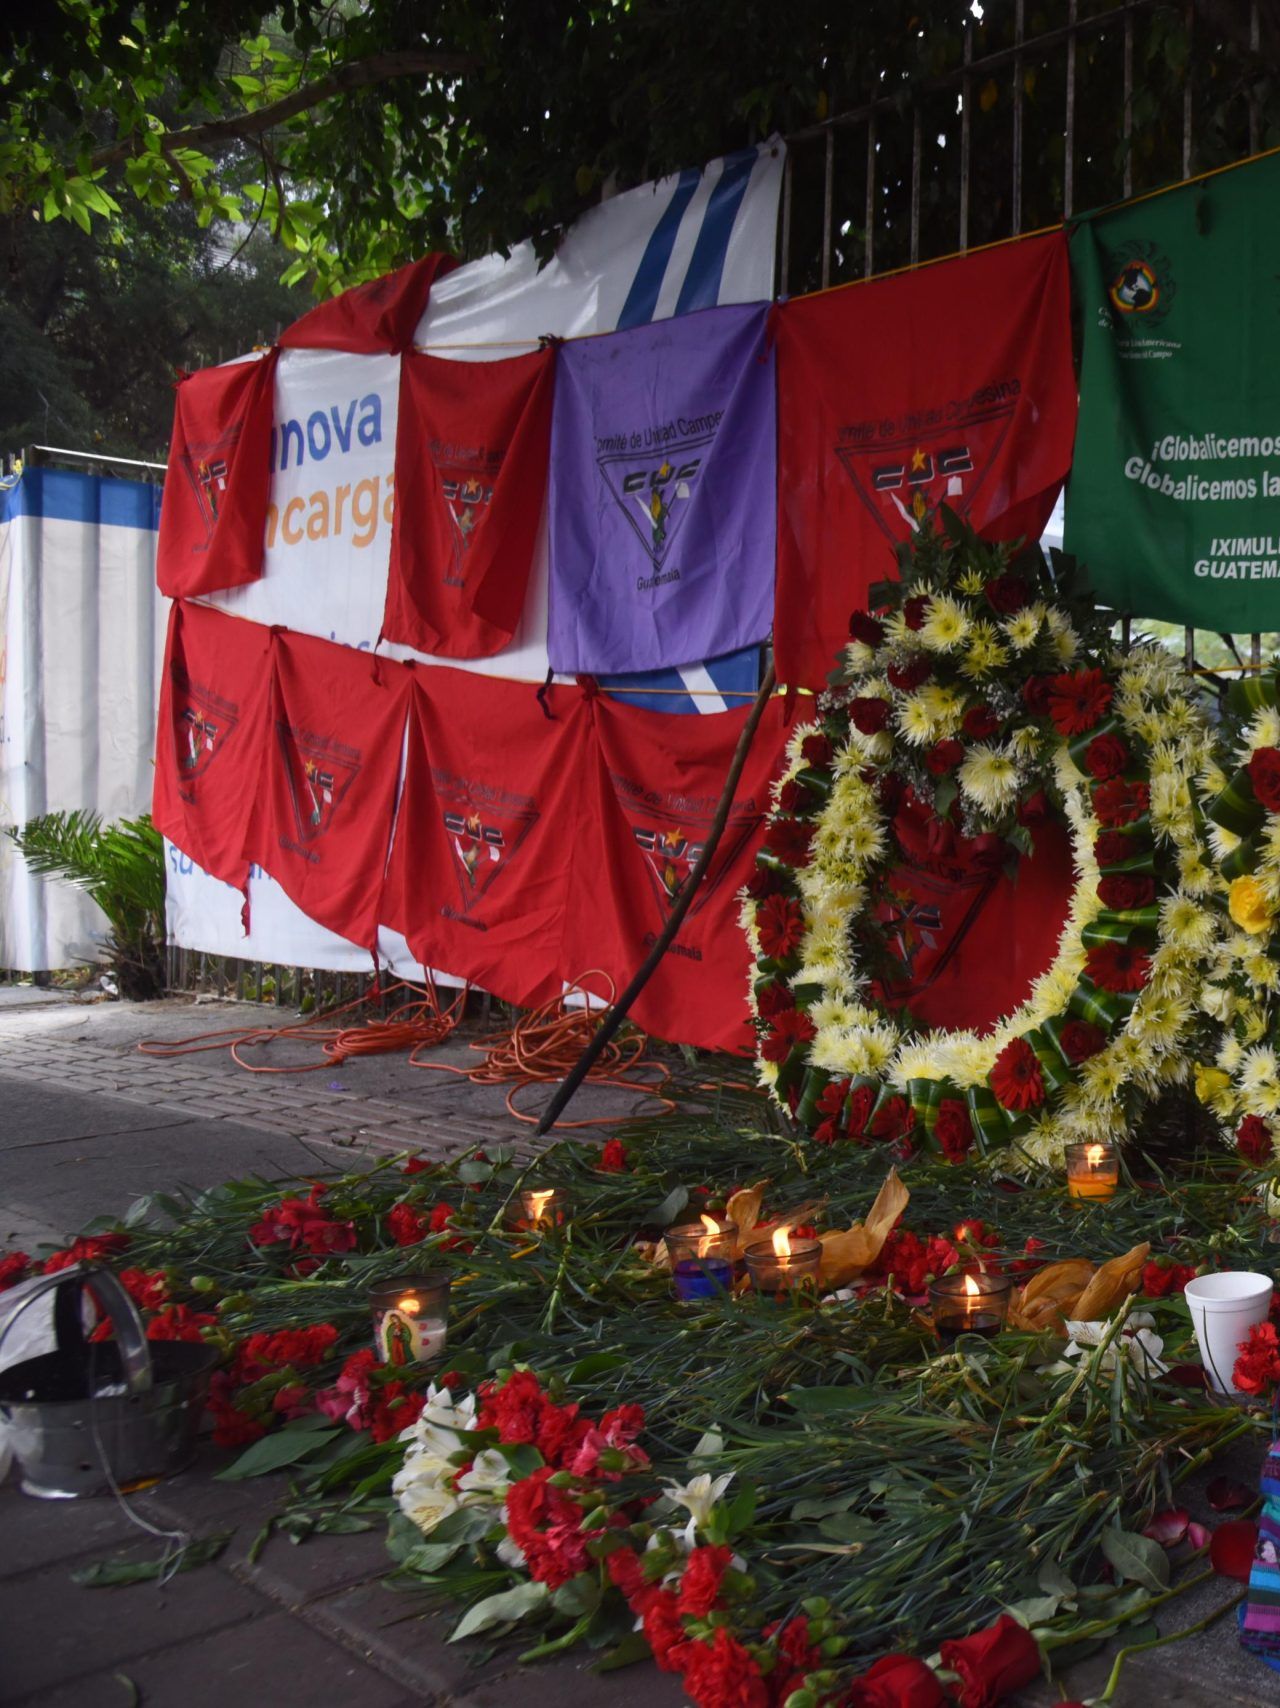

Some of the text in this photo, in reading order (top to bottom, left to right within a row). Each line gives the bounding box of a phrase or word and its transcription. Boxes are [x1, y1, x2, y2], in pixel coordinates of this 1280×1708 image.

[594, 432, 628, 453] omité
[873, 447, 974, 491] CUC
[1124, 456, 1257, 501] Globalicemos
[1262, 471, 1280, 497] la
